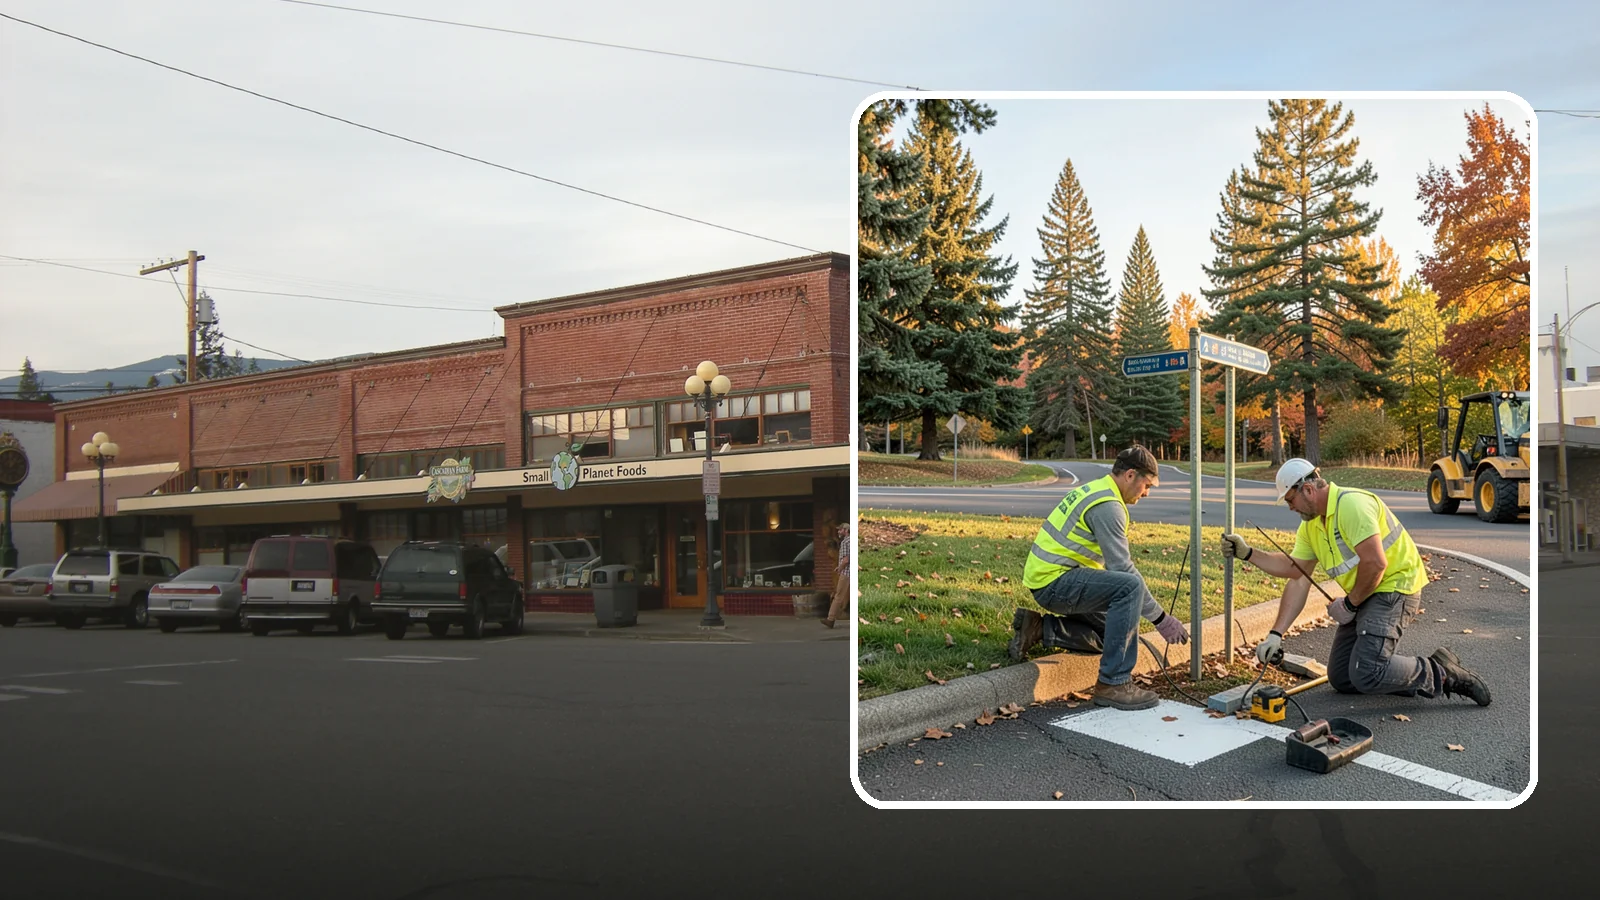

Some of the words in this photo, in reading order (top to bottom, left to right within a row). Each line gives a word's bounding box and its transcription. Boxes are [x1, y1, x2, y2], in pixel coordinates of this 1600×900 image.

[523, 471, 549, 483] Small
[583, 467, 614, 479] Planet
[617, 464, 647, 477] Foods
